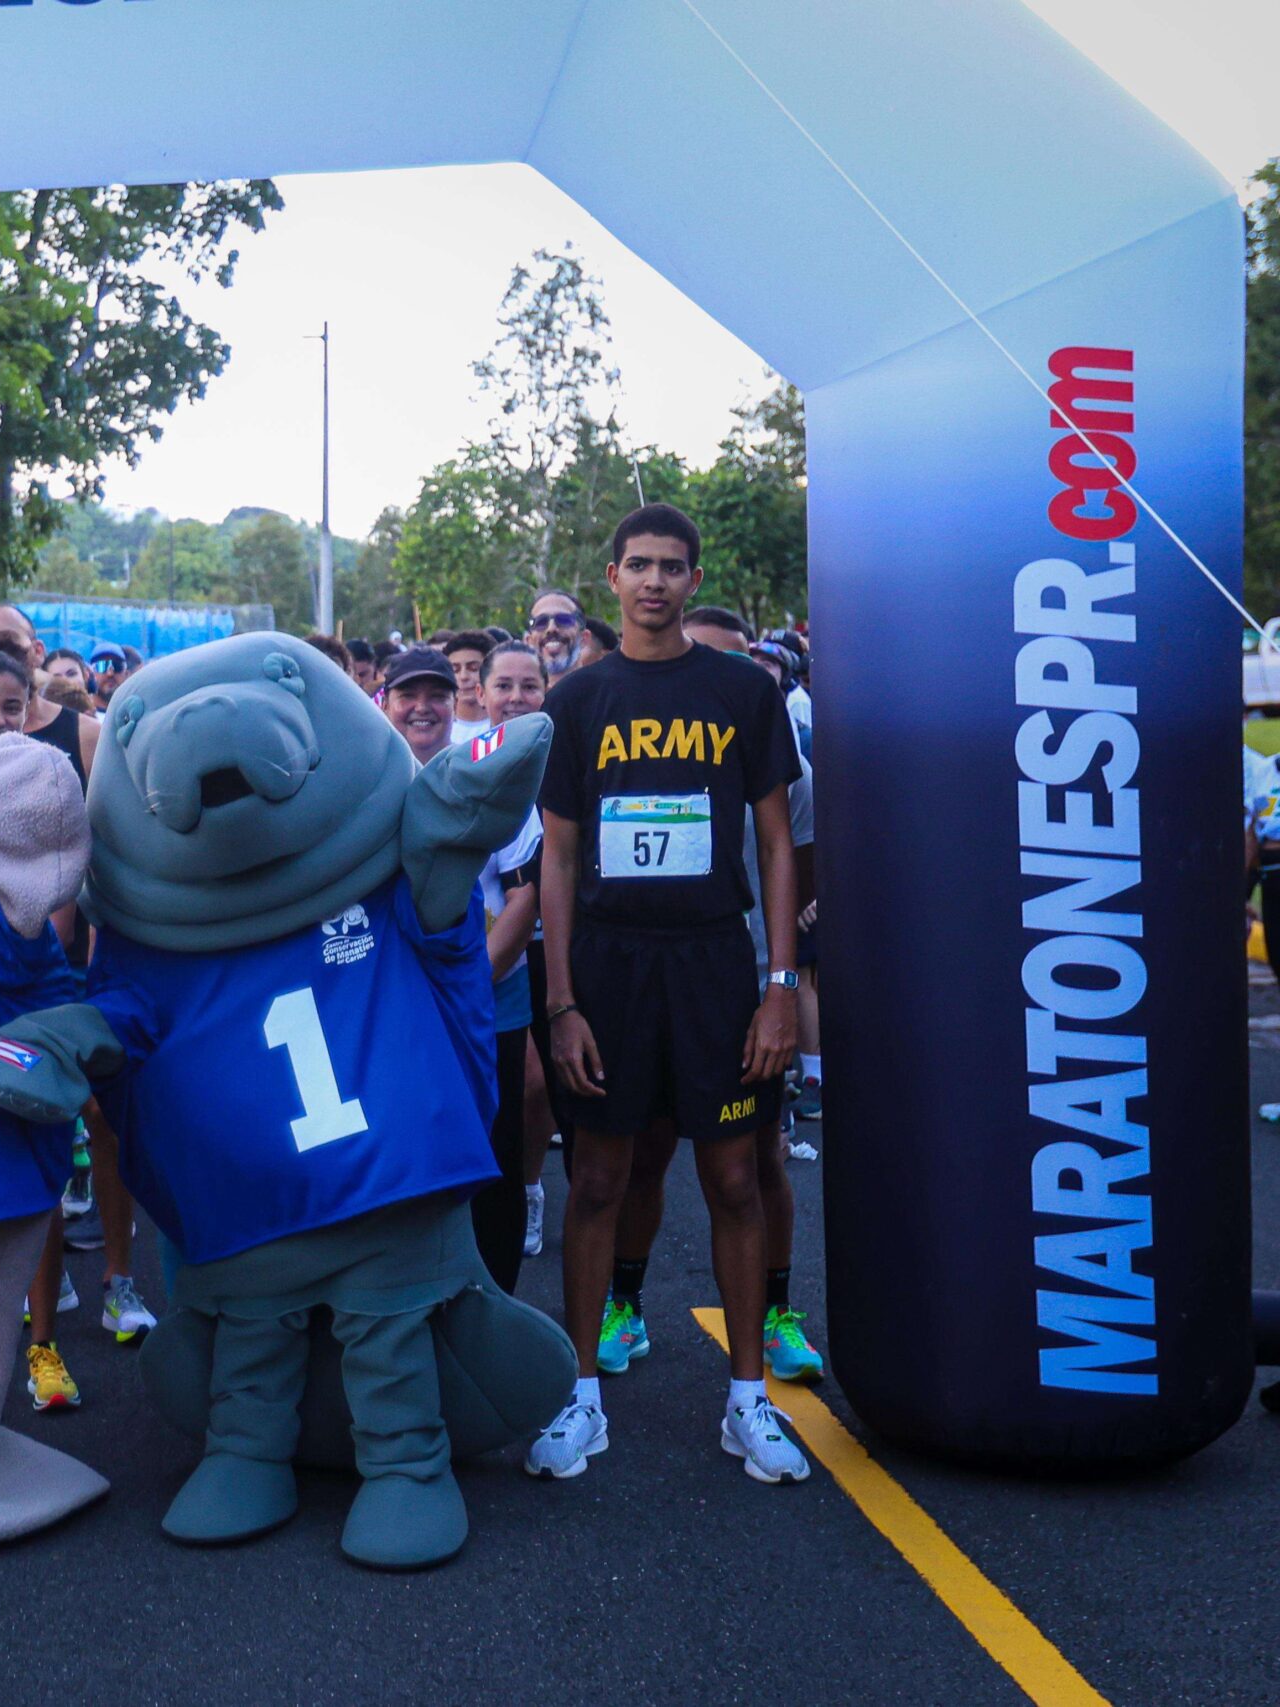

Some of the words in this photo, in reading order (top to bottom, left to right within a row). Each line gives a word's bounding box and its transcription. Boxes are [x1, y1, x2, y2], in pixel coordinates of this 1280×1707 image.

[597, 718, 736, 770] ARMY
[633, 831, 671, 867] 57
[1013, 345, 1159, 1397] MARATONESPR.com
[263, 986, 369, 1153] 1
[719, 1094, 756, 1123] ARMY
